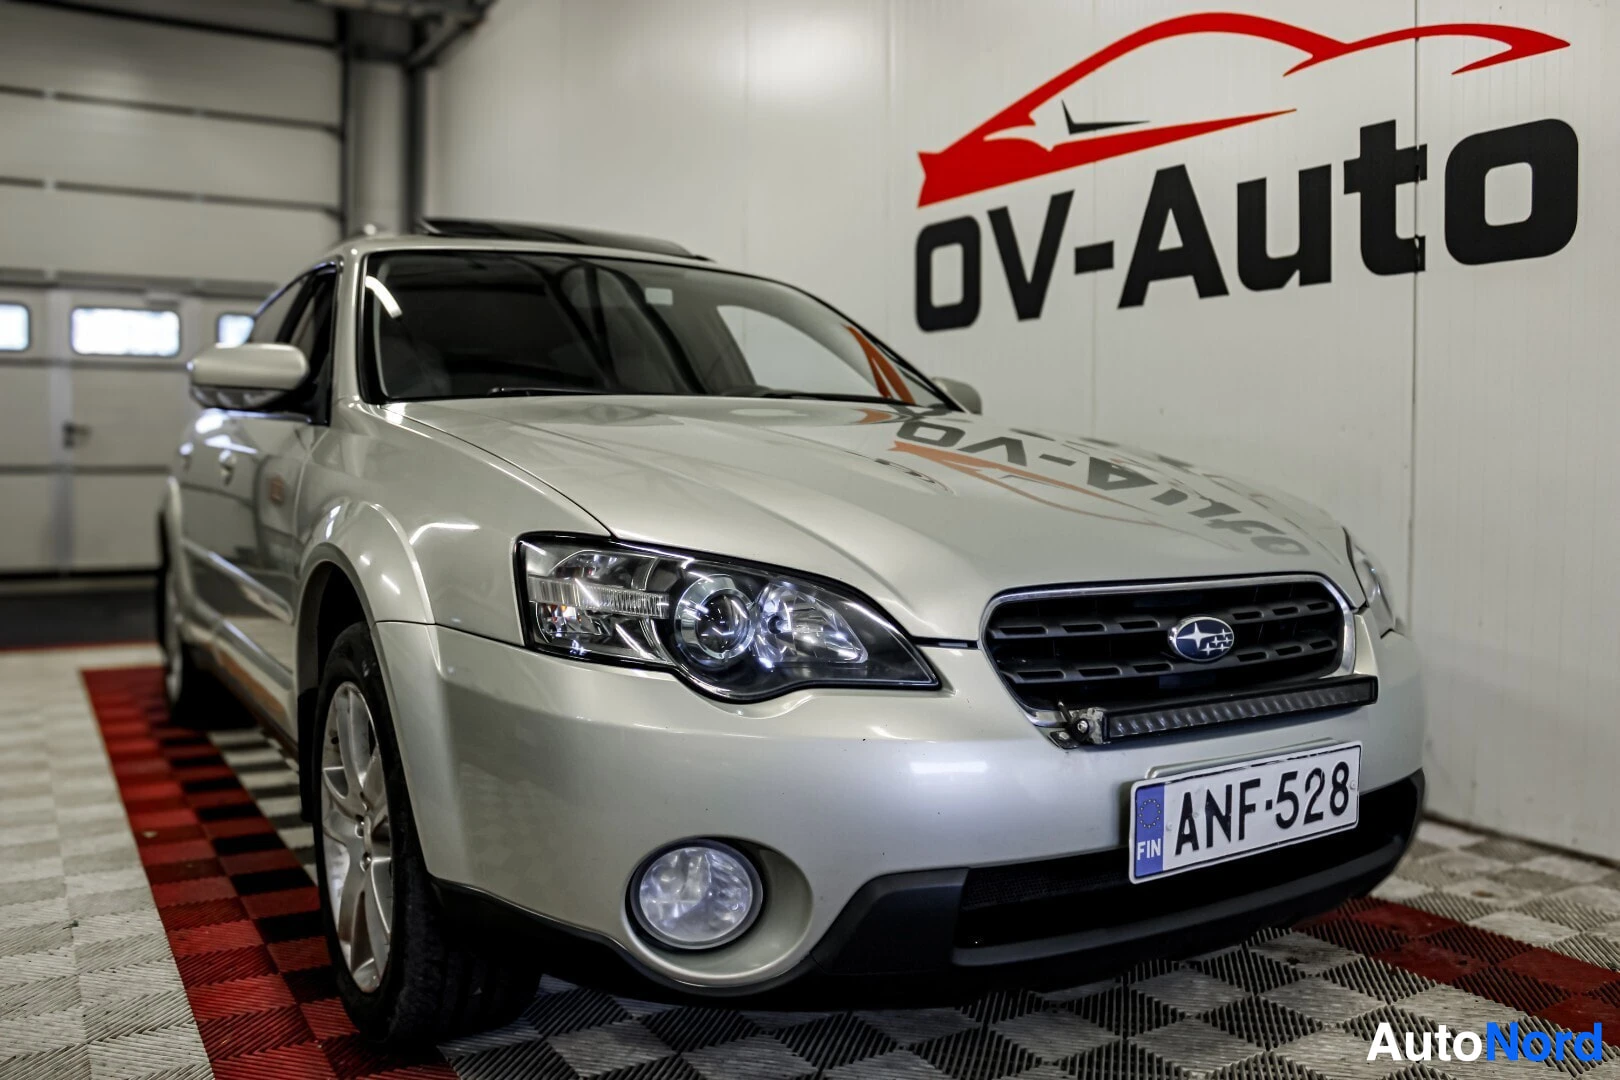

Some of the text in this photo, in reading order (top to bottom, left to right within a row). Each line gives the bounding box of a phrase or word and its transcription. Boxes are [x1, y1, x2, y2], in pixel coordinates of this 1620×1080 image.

[916, 119, 1578, 332] OV-Auto
[1137, 838, 1162, 861] FIN
[1175, 761, 1350, 856] ANF-528
